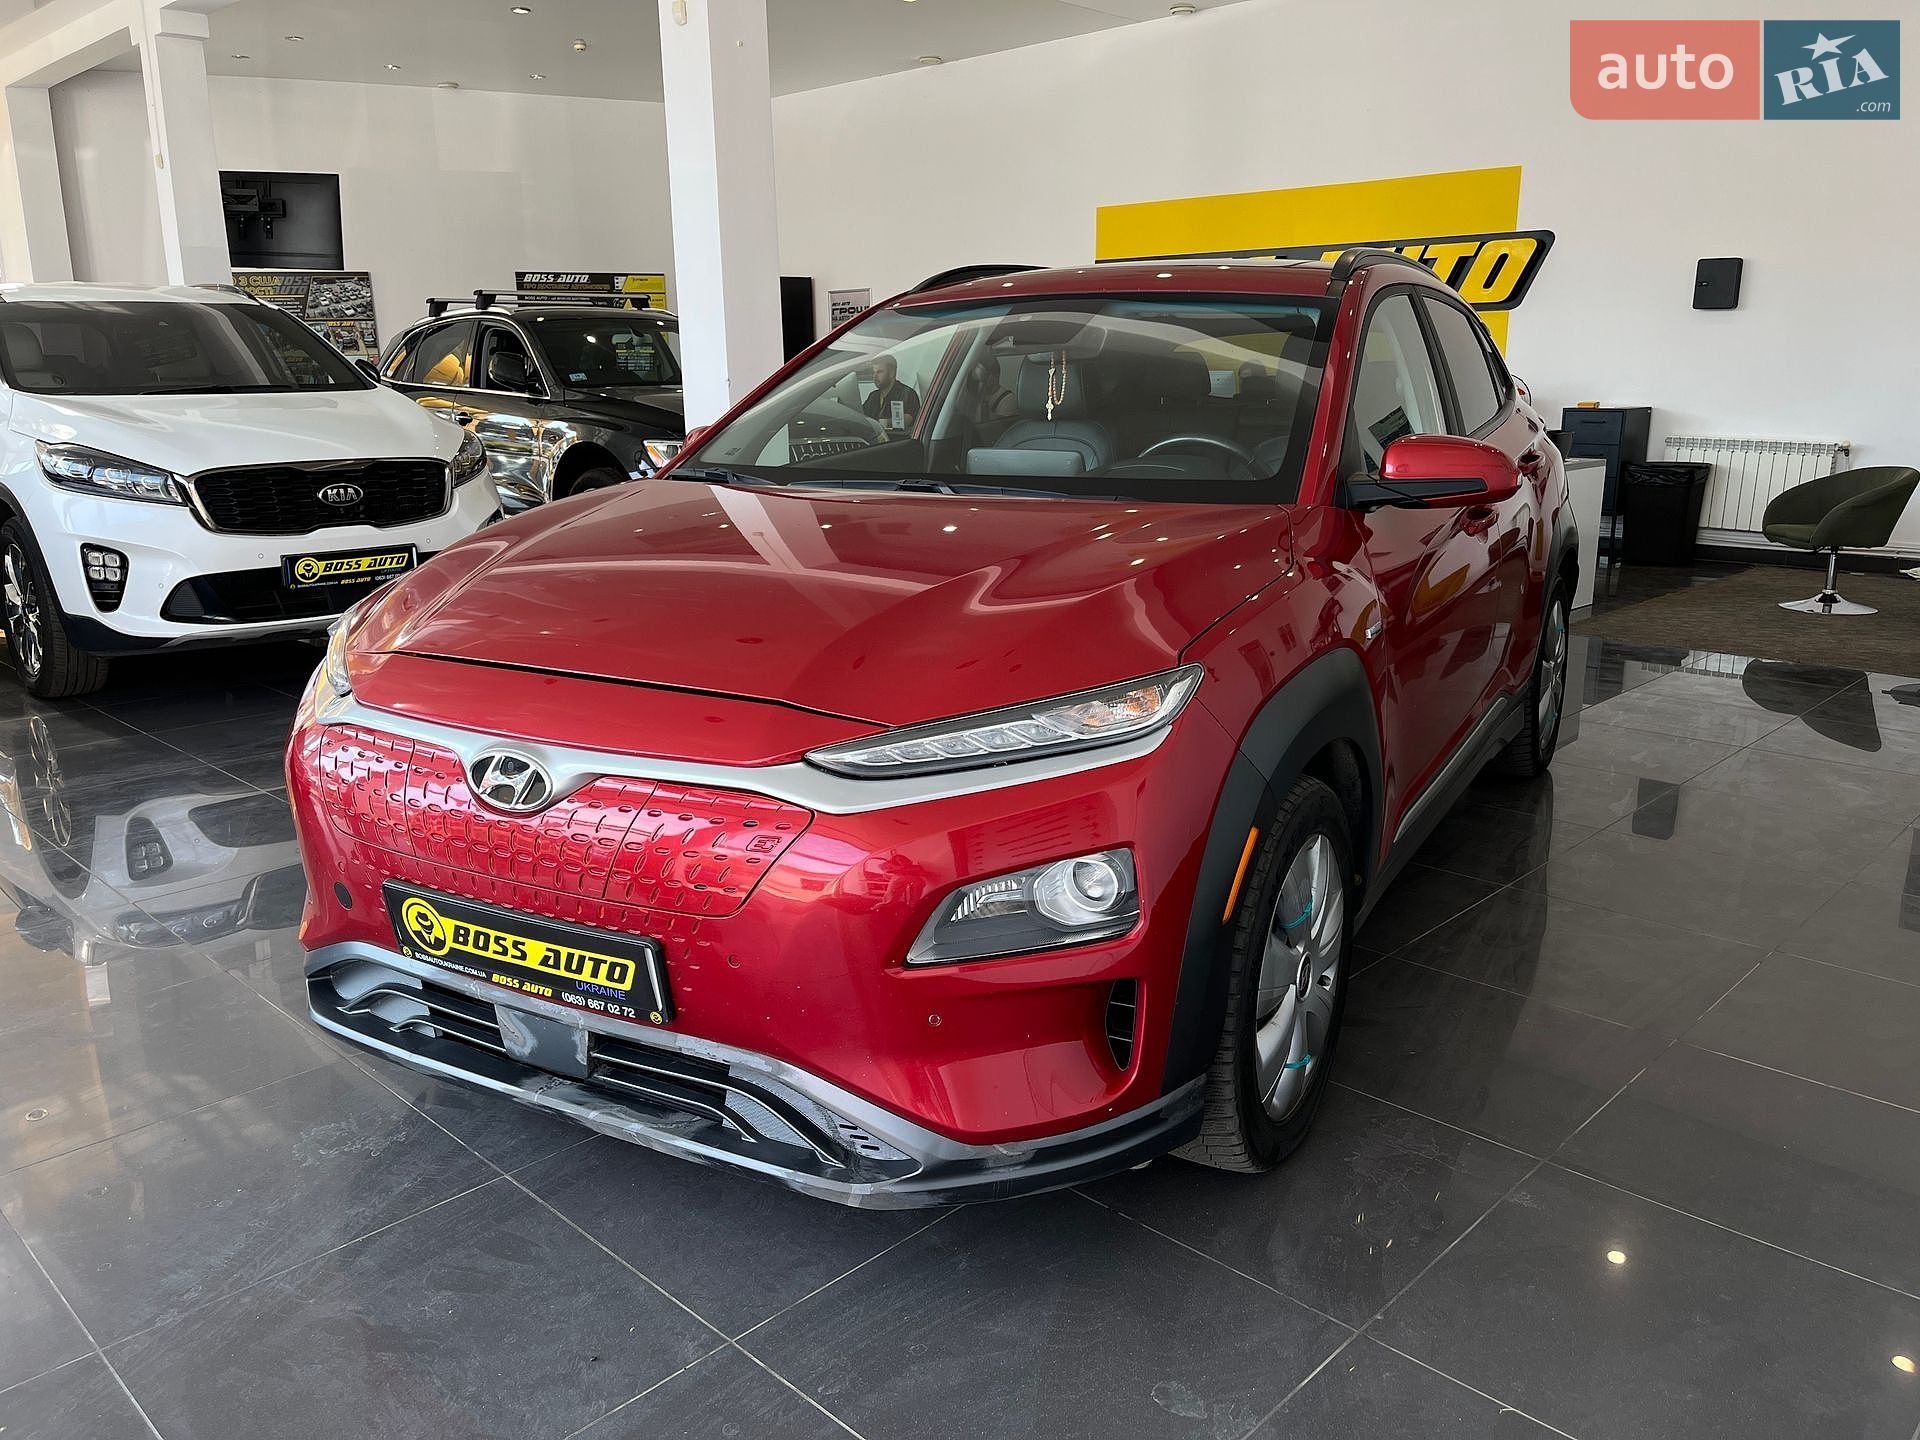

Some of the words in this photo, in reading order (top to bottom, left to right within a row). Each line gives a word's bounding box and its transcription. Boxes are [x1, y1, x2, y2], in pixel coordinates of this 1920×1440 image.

[523, 273, 555, 283] BOSS
[557, 274, 590, 283] AUTO
[326, 487, 358, 502] KIA
[322, 560, 362, 573] BOSS
[365, 555, 407, 569] AUTO
[415, 952, 487, 978] BOSSAUTOUKRAINE.COM.UA
[451, 924, 528, 961] BOSS
[538, 947, 630, 985] AUTO
[491, 973, 520, 989] BOSS
[521, 981, 553, 997] AUTO
[575, 980, 626, 1000] UKRAINE
[561, 991, 586, 1006] (063)
[587, 998, 605, 1011] 667
[607, 1003, 621, 1014] 02
[621, 1006, 636, 1018] 72
